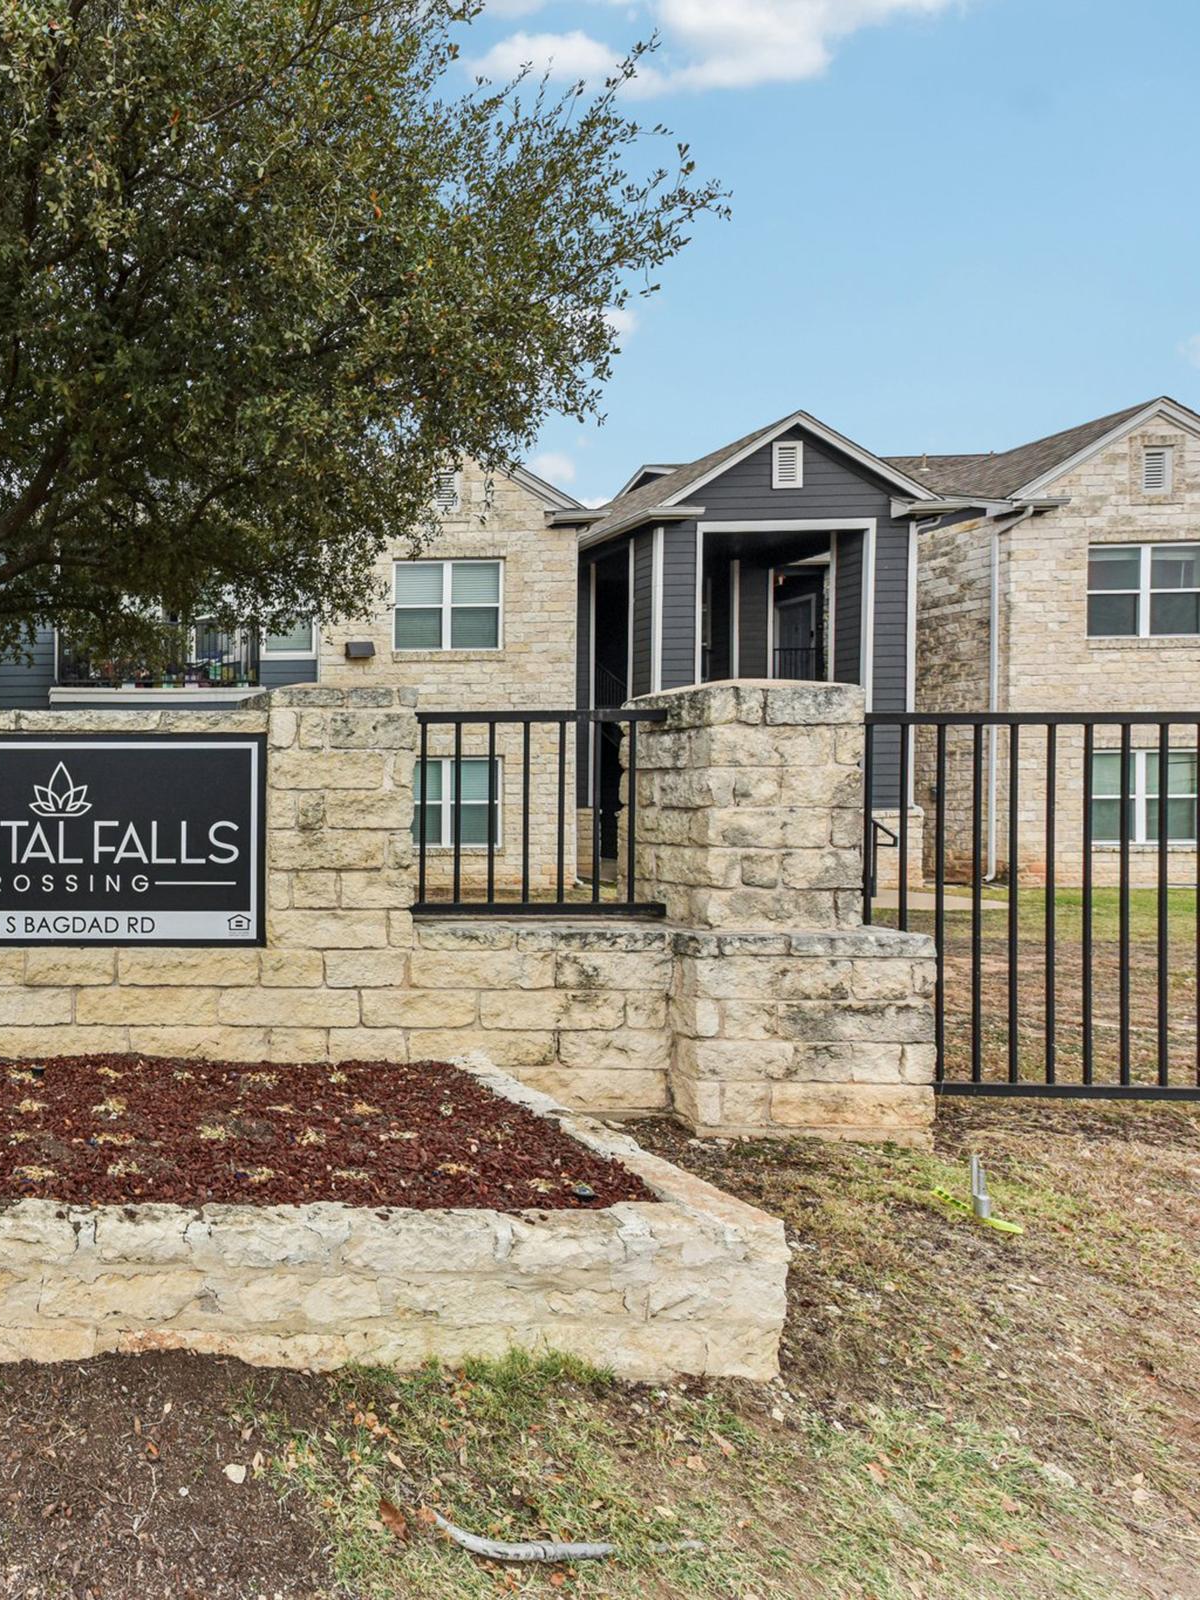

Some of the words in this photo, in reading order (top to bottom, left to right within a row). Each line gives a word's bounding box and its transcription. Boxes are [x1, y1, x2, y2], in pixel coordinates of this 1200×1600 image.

[93, 820, 240, 864] FALLS
[5, 916, 17, 934] S
[24, 916, 119, 934] BAGDAD
[127, 916, 156, 934] RD
